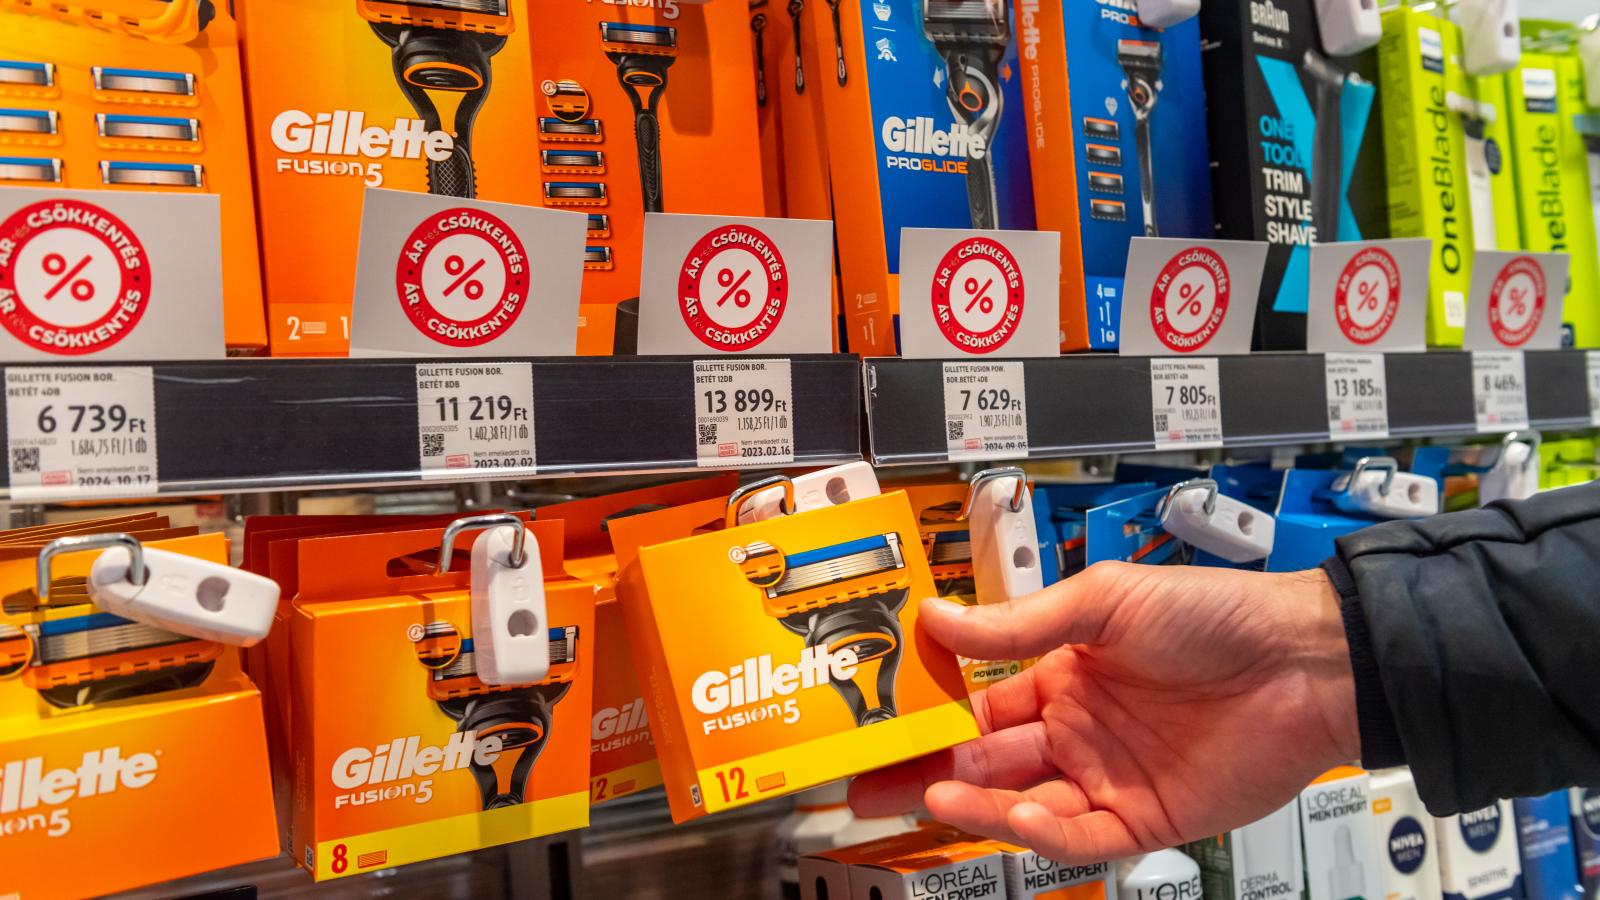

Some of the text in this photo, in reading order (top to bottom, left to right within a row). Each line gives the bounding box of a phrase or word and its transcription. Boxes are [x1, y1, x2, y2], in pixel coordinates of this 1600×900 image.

[1250, 0, 1289, 33] BRAUN
[1031, 64, 1045, 149] PROGLIDE
[271, 109, 454, 162] Gillette
[882, 116, 986, 160] Gillette
[1259, 115, 1294, 141] ONE
[886, 155, 969, 174] PROGLIDE
[1261, 141, 1303, 168] TOOL
[1262, 167, 1303, 194] TRIM
[1426, 85, 1461, 275] OneBlade
[1264, 194, 1313, 222] STYLE
[27, 203, 141, 270] CSÖKKENTÉS
[405, 239, 427, 264] ÁR
[437, 212, 523, 274] CSÖKKENTÉS
[1266, 221, 1317, 246] SHAVE
[685, 256, 703, 279] ÁR
[711, 228, 782, 282] CSÖKKENTÉS
[936, 241, 1019, 289] ÁR CSÖKKENTÉS
[28, 289, 141, 348] CSÖKKENTÉS
[404, 282, 421, 306] ÁR
[427, 292, 520, 340] CSÖKKENTÉS
[685, 296, 699, 318] ÁR
[705, 298, 780, 344] CSÖKKENTÉS
[287, 316, 349, 341] 2 1
[937, 304, 950, 324] ÁR
[956, 304, 1019, 347] CSÖKKENTÉS
[7, 373, 117, 383] GILLETTE FUSION BOR.
[418, 368, 453, 377] GILLETTE
[455, 368, 484, 376] FUSION
[695, 363, 767, 372] GILLETTE FUSION BOR.
[696, 375, 733, 383] BETÉT 12DB
[8, 386, 61, 397] BETÉT 4DB
[419, 379, 460, 389] BETÉT 8DB
[1165, 386, 1174, 405] 7
[1334, 378, 1348, 397] 13
[435, 396, 459, 421] 11
[704, 390, 727, 413] 13
[960, 390, 971, 410] 7
[37, 405, 57, 433] 6
[737, 416, 762, 432] 1.158,25
[469, 426, 498, 442] 1.402,38
[474, 457, 533, 468] 20230202
[741, 446, 791, 457] 2023.02.16
[78, 475, 151, 486] 20241017
[691, 643, 859, 715] Gillette
[973, 667, 1005, 679] POWER
[331, 730, 502, 789] Gillette
[715, 766, 749, 804] 12
[1308, 811, 1332, 823] MEN
[1333, 800, 1367, 818] EXPERT
[1462, 804, 1499, 827] NIVEA
[1391, 832, 1424, 853] NIVEA
[1469, 823, 1496, 839] MEN
[331, 843, 348, 874] 8
[1397, 849, 1420, 863] MEN
[911, 863, 997, 897] L'ORÉAL
[1024, 870, 1056, 890] MEN
[1059, 861, 1109, 882] EXPERT
[1137, 874, 1204, 900] L'ORÉ
[1240, 871, 1279, 891] DERMA
[948, 881, 998, 900] EXPERT
[1241, 881, 1293, 900] CONTROL
